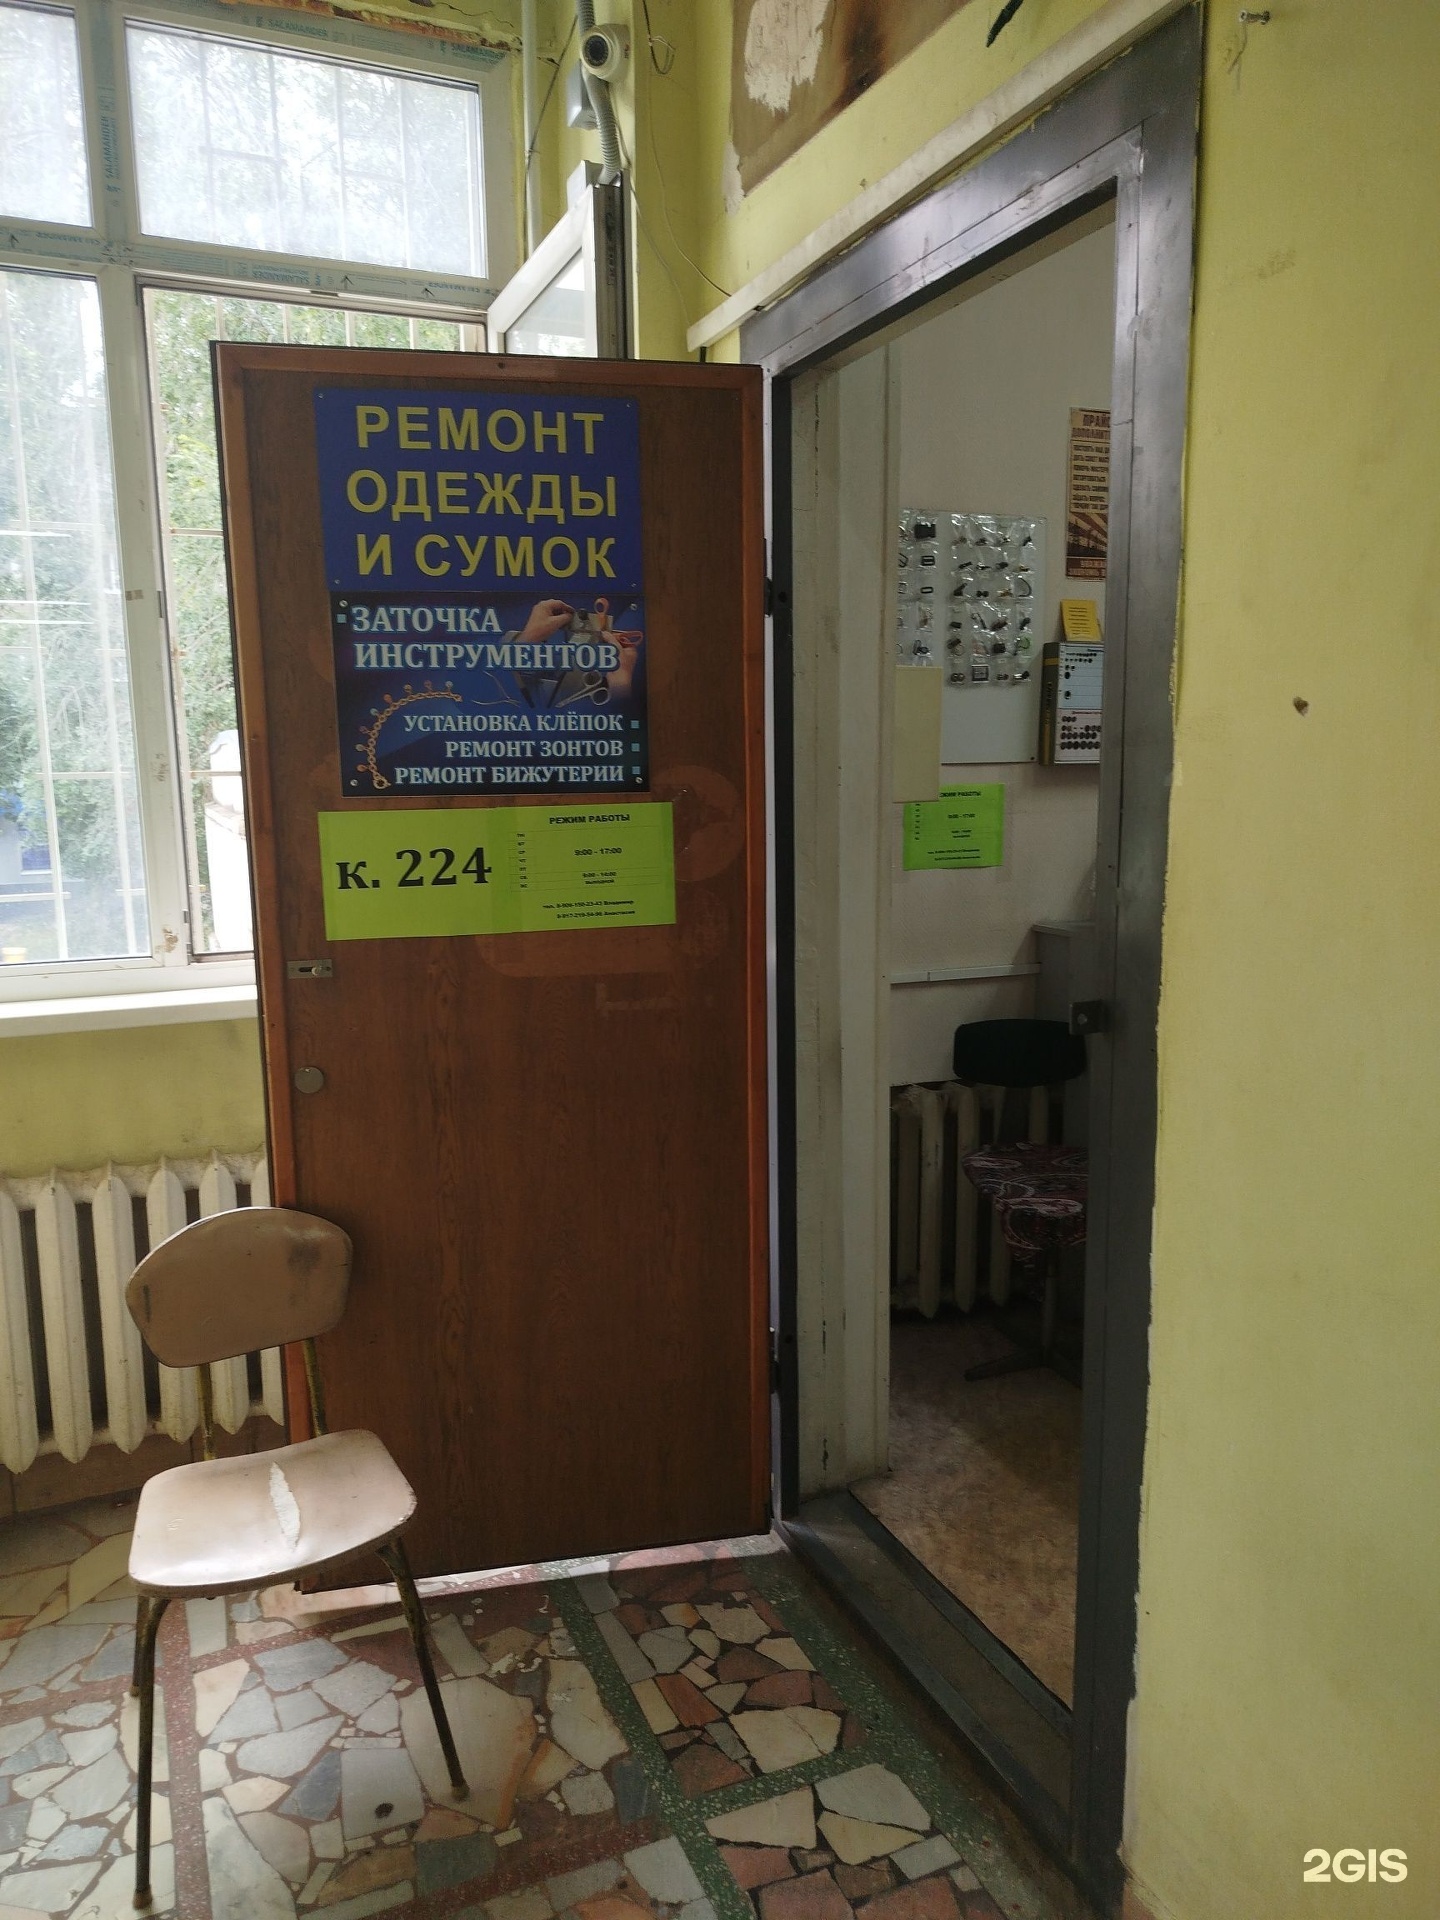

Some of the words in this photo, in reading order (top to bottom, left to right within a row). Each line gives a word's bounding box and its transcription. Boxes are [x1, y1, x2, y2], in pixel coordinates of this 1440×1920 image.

[355, 405, 605, 454] РЕМОНТ
[347, 469, 617, 524] ОДЕЖДЫ
[355, 533, 393, 576] И
[414, 534, 617, 578] СУМОК
[351, 605, 503, 634] ЗАТОЧКА
[353, 642, 619, 670] ИНСТРУМЕНТОВ
[404, 715, 531, 732] УСТАНОВКА
[536, 711, 624, 732] КЛЁПОК
[445, 741, 535, 758] РЕМОНТ
[539, 740, 624, 757] ЗОНТОВ
[394, 767, 488, 785] РЕМОНТ
[491, 765, 625, 784] БИЖУТЕРИИ
[549, 816, 587, 824] РЕЖИМ
[588, 814, 630, 823] РАБОТЫ
[600, 847, 622, 855] 17:00
[395, 847, 492, 888] 224
